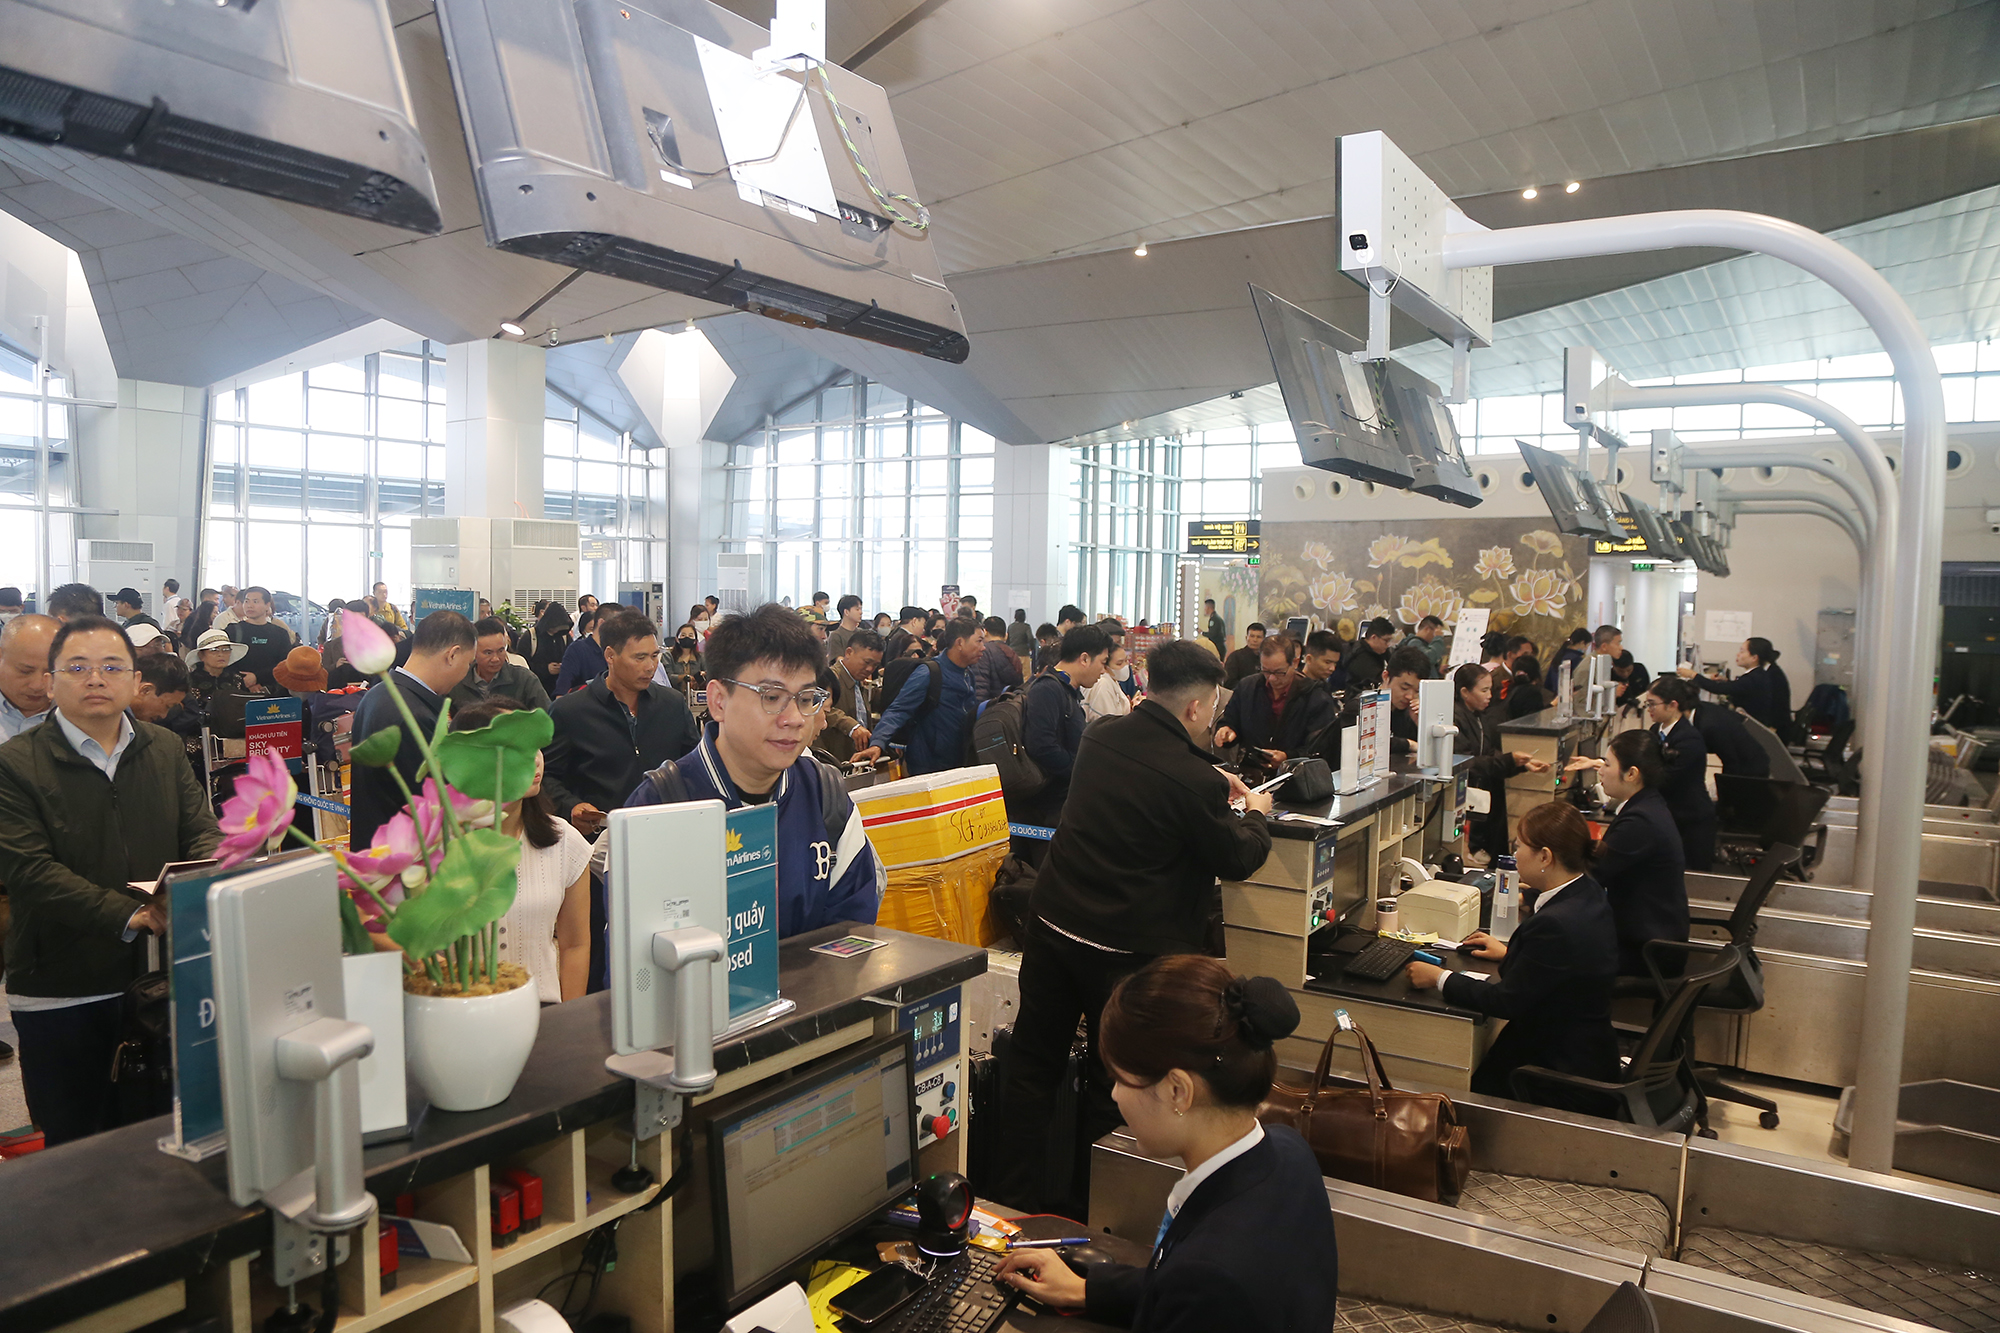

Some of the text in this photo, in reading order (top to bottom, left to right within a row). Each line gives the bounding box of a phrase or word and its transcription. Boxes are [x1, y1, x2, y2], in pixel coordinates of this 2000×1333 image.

[249, 741, 268, 750] SKY
[249, 746, 290, 757] PRIOITY
[1017, 826, 1038, 836] QUỐC
[1038, 828, 1048, 838] TẾ
[734, 900, 766, 935] quầy
